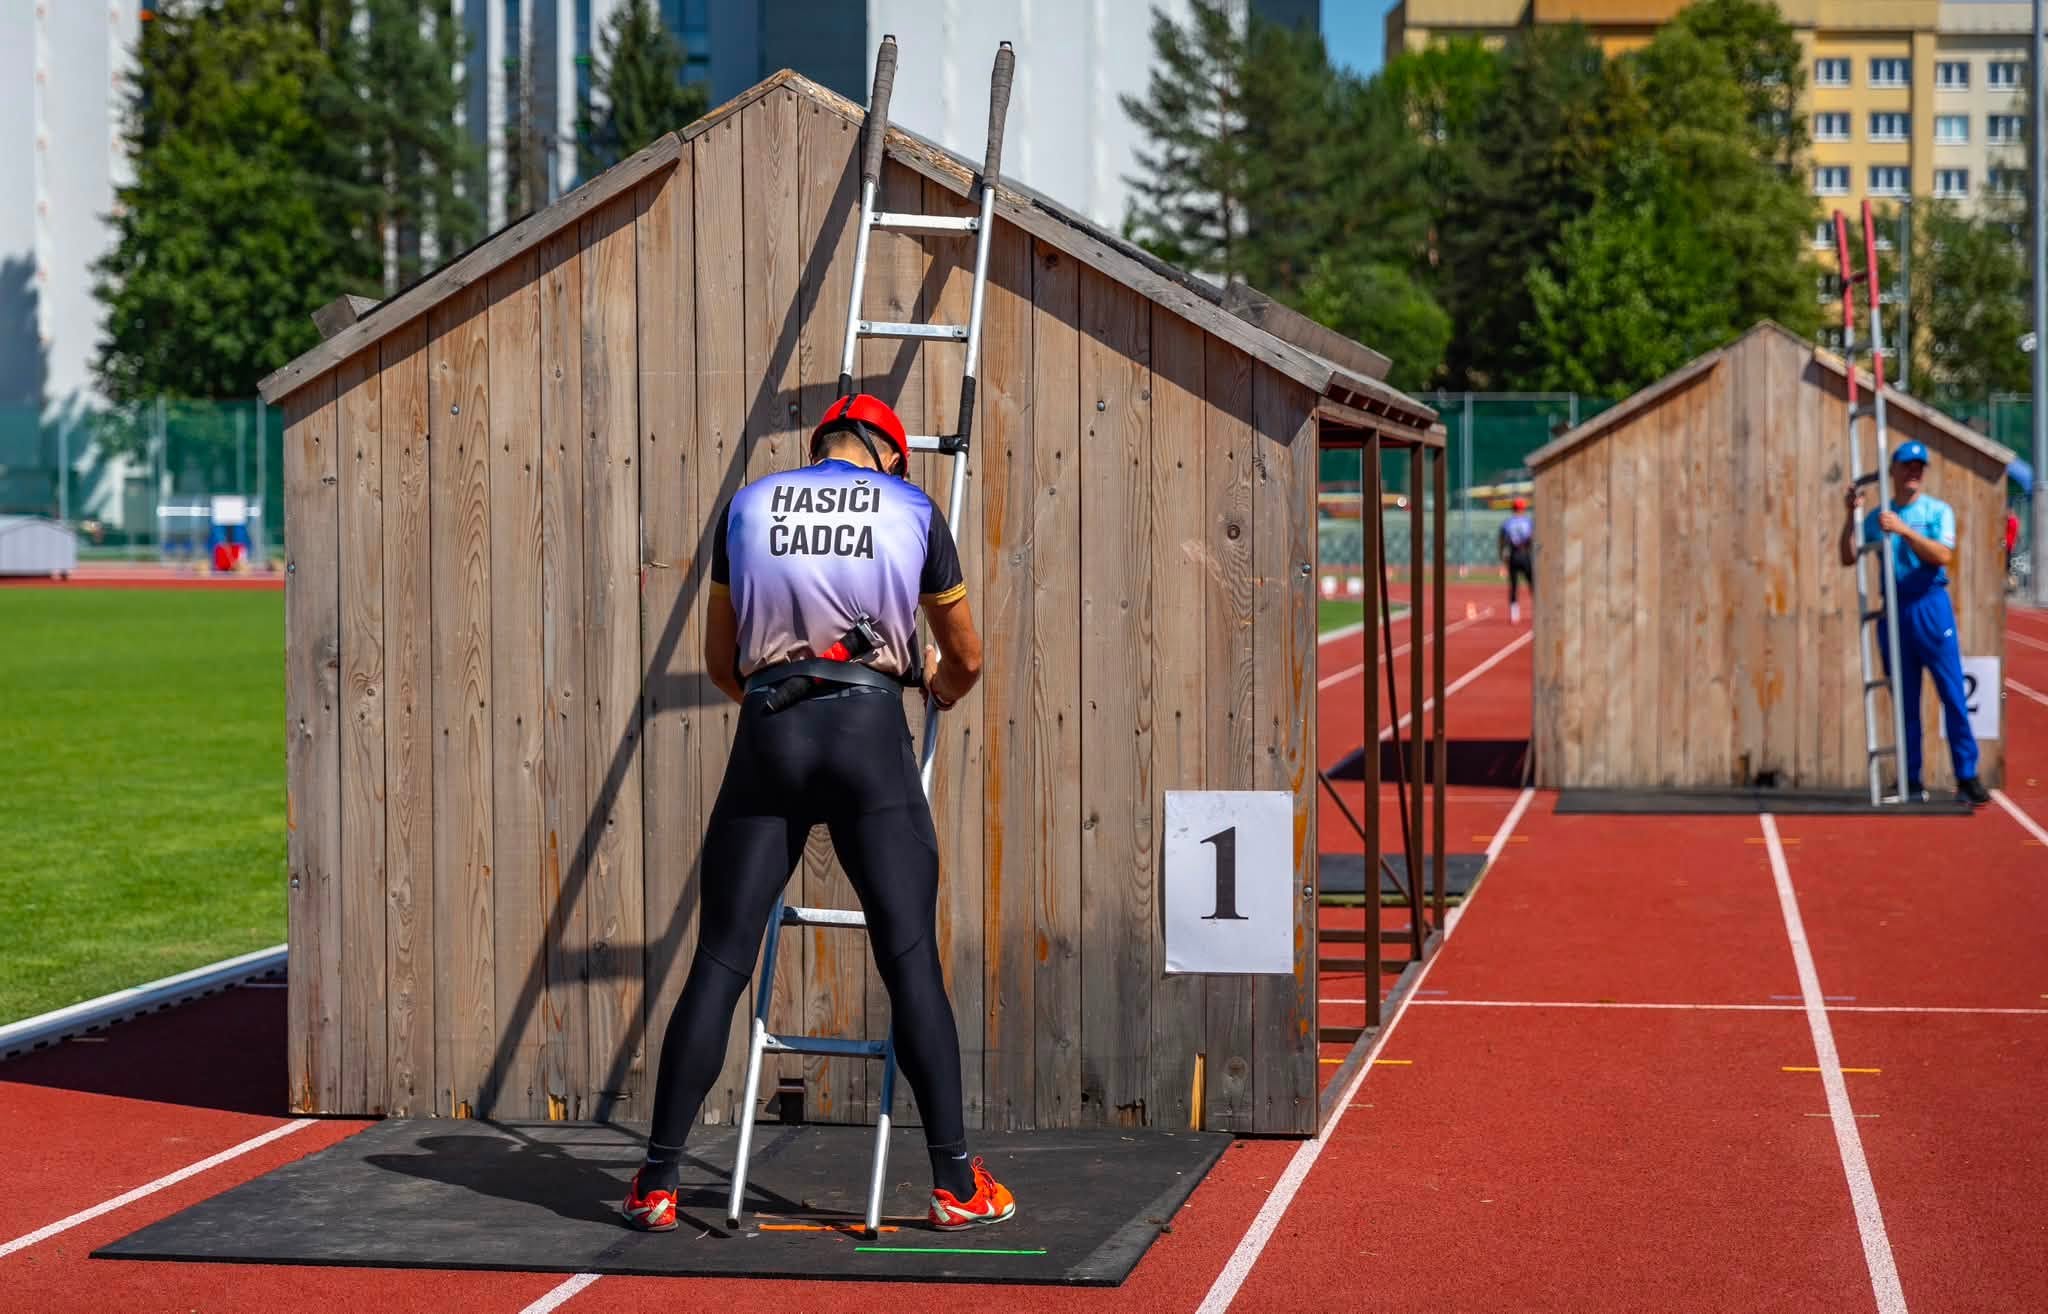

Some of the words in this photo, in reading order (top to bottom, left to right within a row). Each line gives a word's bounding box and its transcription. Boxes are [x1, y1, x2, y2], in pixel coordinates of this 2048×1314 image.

[770, 480, 881, 514] HASIČI
[769, 515, 874, 560] ČADCA
[1199, 825, 1249, 920] 1
